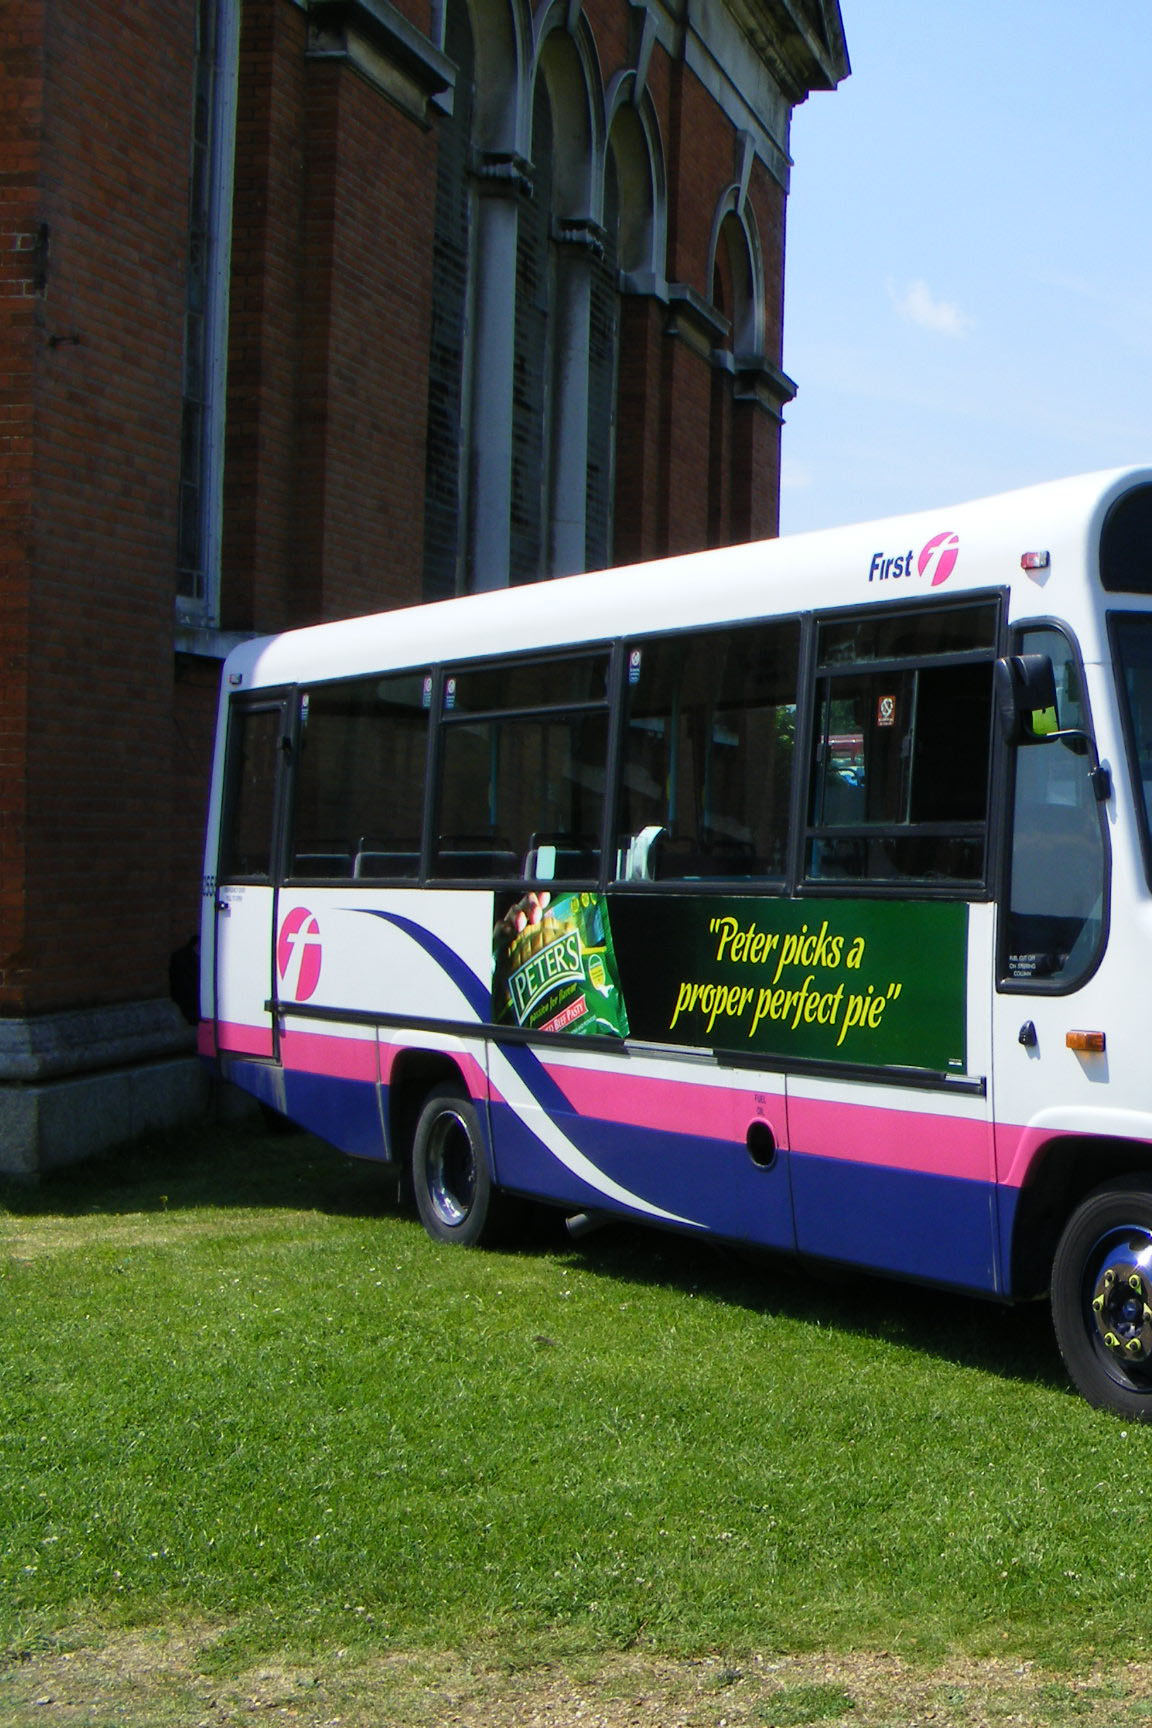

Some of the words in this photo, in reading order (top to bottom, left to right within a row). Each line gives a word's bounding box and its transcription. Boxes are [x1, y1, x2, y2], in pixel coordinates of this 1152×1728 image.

[868, 550, 914, 582] First
[709, 916, 779, 961] "Peter
[772, 920, 844, 985] picks
[846, 936, 866, 969] a
[669, 982, 755, 1034] proper
[748, 975, 845, 1038] perfect
[837, 983, 902, 1046] pie"
